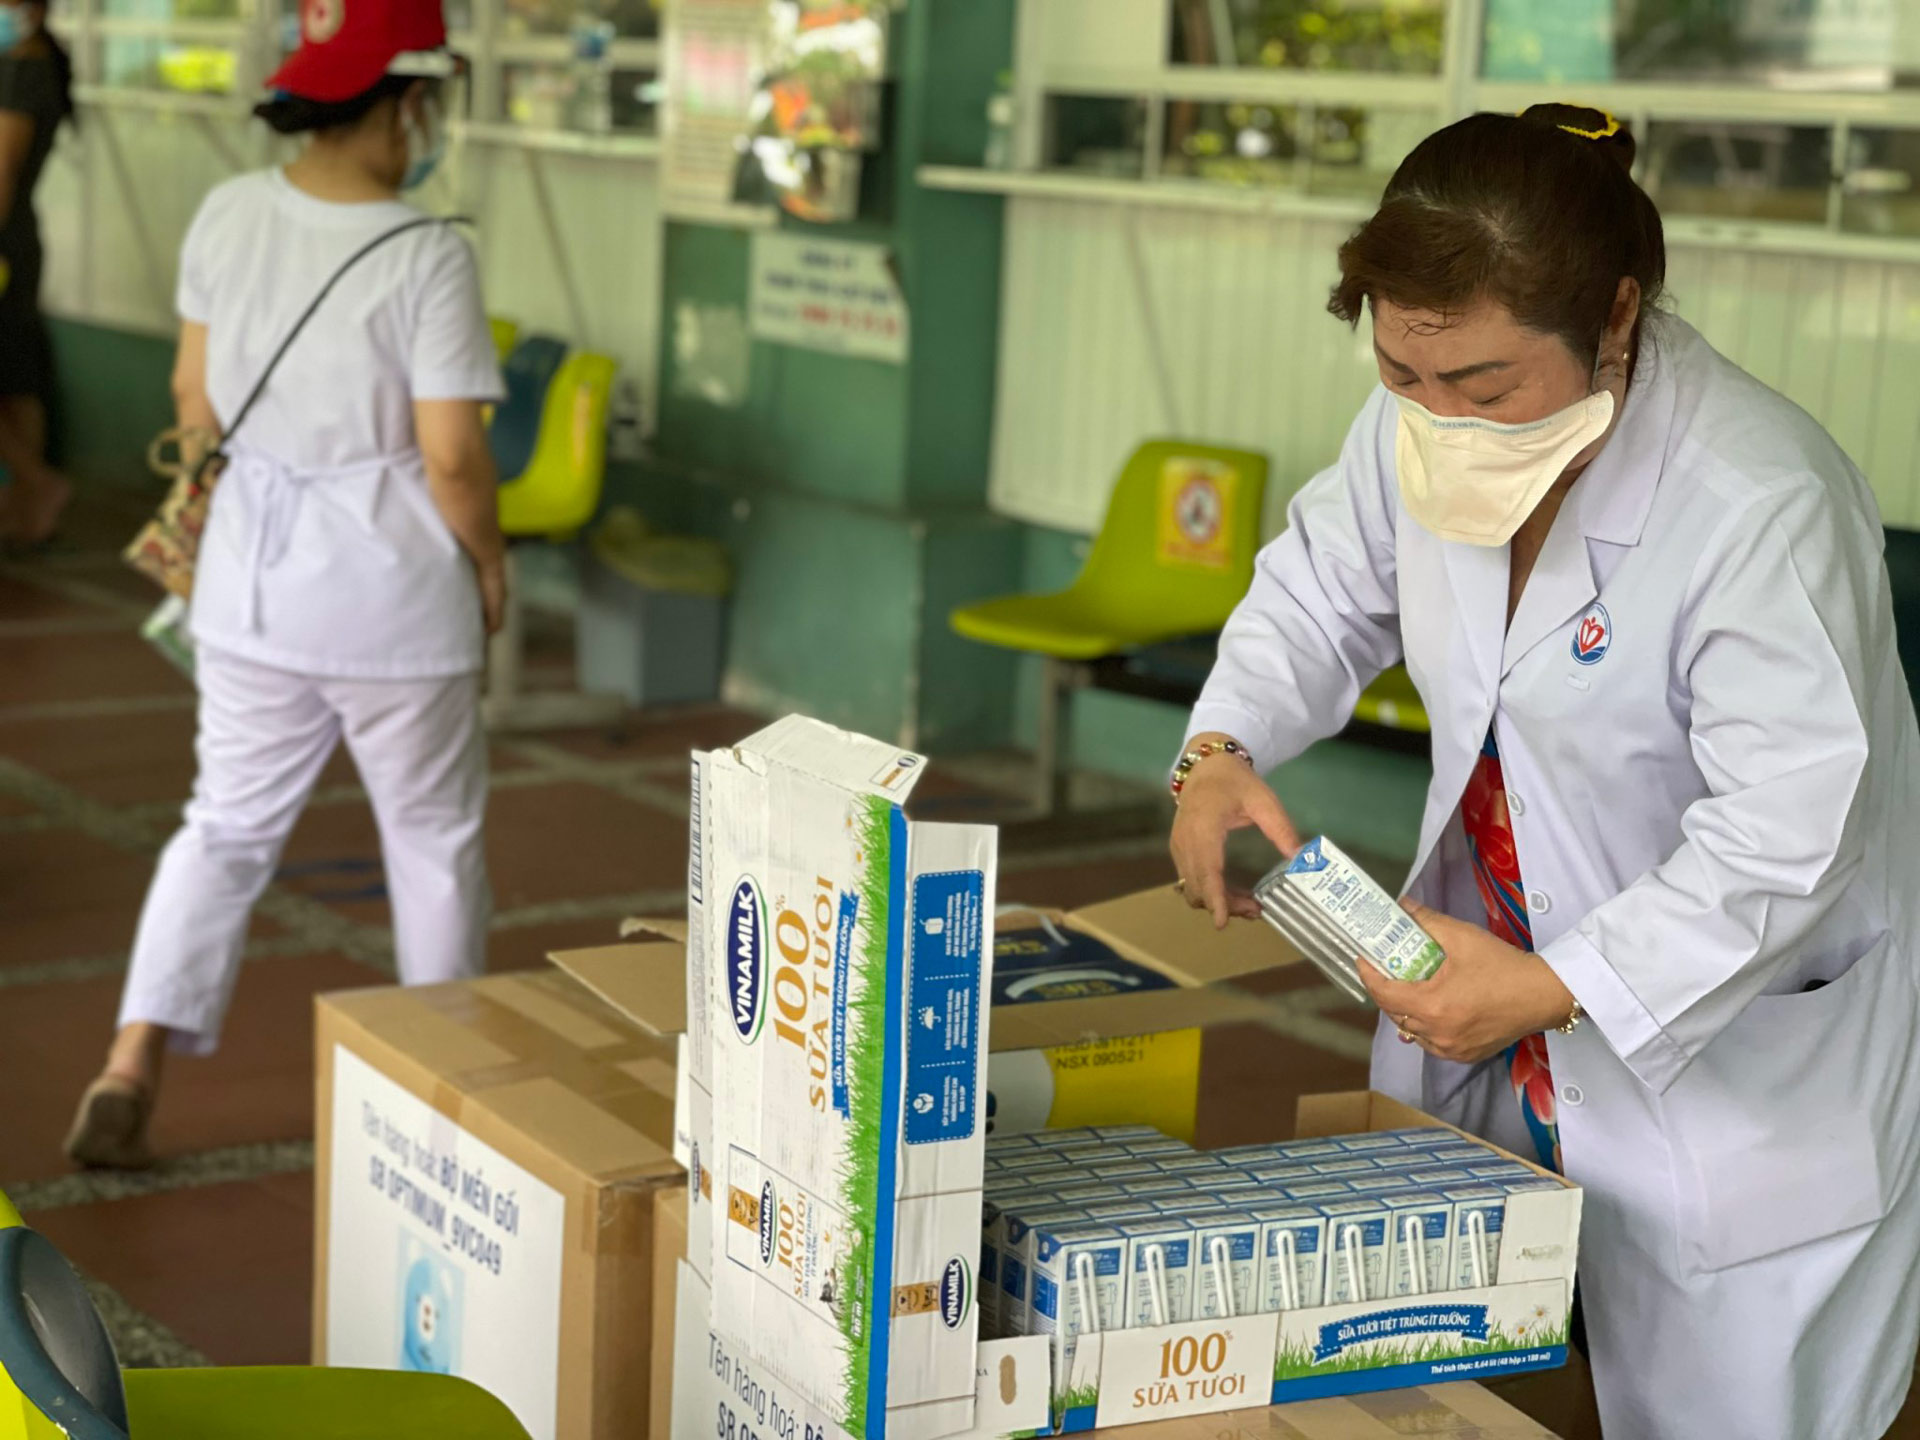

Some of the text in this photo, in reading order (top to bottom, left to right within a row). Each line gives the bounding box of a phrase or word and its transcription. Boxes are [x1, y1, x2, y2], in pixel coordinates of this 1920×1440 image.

[736, 889, 754, 1026] VINAMILK
[773, 894, 810, 1050] 100%
[808, 875, 833, 1113] SỮA TƯƠI
[1056, 1049, 1143, 1069] NSX 090521
[761, 1185, 773, 1258] VINAMILK
[946, 1260, 960, 1325] VINAMILK
[1337, 1325, 1355, 1341] SỮA
[1357, 1320, 1379, 1336] TƯƠI
[1380, 1316, 1398, 1332] TIỆT
[1399, 1312, 1429, 1328] TRÙNG
[1429, 1311, 1439, 1326] ÍT
[709, 1330, 731, 1384] Tên
[734, 1357, 767, 1426] hàng
[1159, 1330, 1233, 1379] 100%
[1133, 1373, 1246, 1408] SỮA TƯƠI
